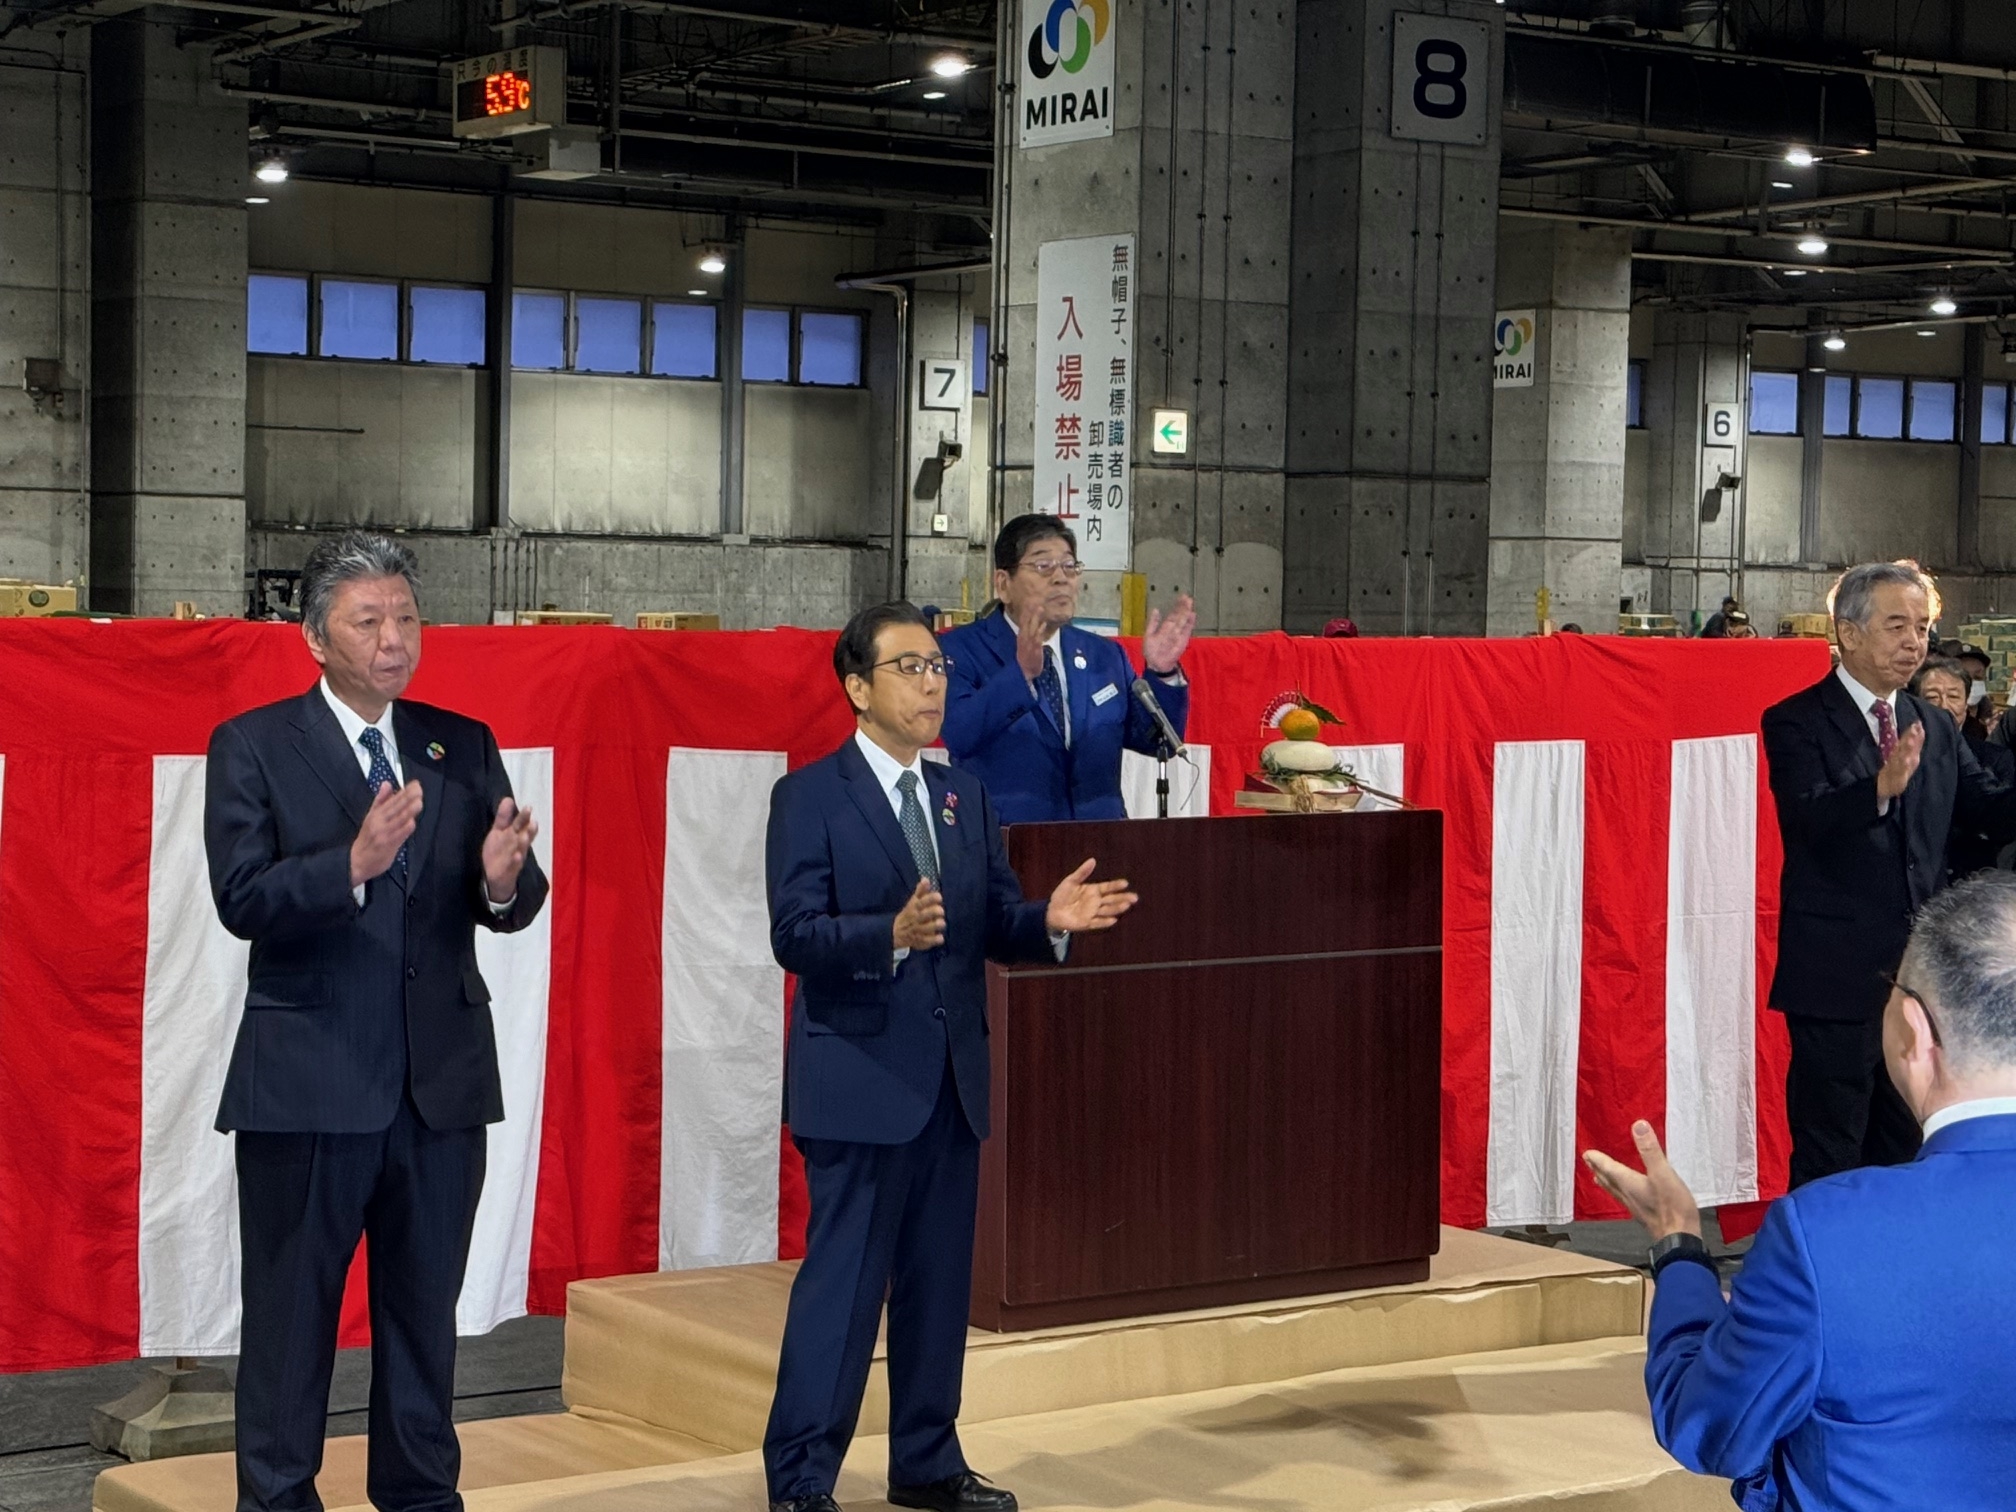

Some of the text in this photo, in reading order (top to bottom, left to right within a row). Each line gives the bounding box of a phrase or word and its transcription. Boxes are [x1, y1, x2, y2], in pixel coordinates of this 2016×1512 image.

[1026, 86, 1108, 130] MIRAI
[1413, 39, 1467, 119] 8
[933, 367, 956, 398] 7
[1107, 244, 1129, 510] 無帽子、無標識者の
[1494, 363, 1531, 379] IRAI
[1055, 296, 1083, 519] 入場禁止
[1714, 410, 1731, 437] 6
[1087, 420, 1104, 542] 卸売場内
